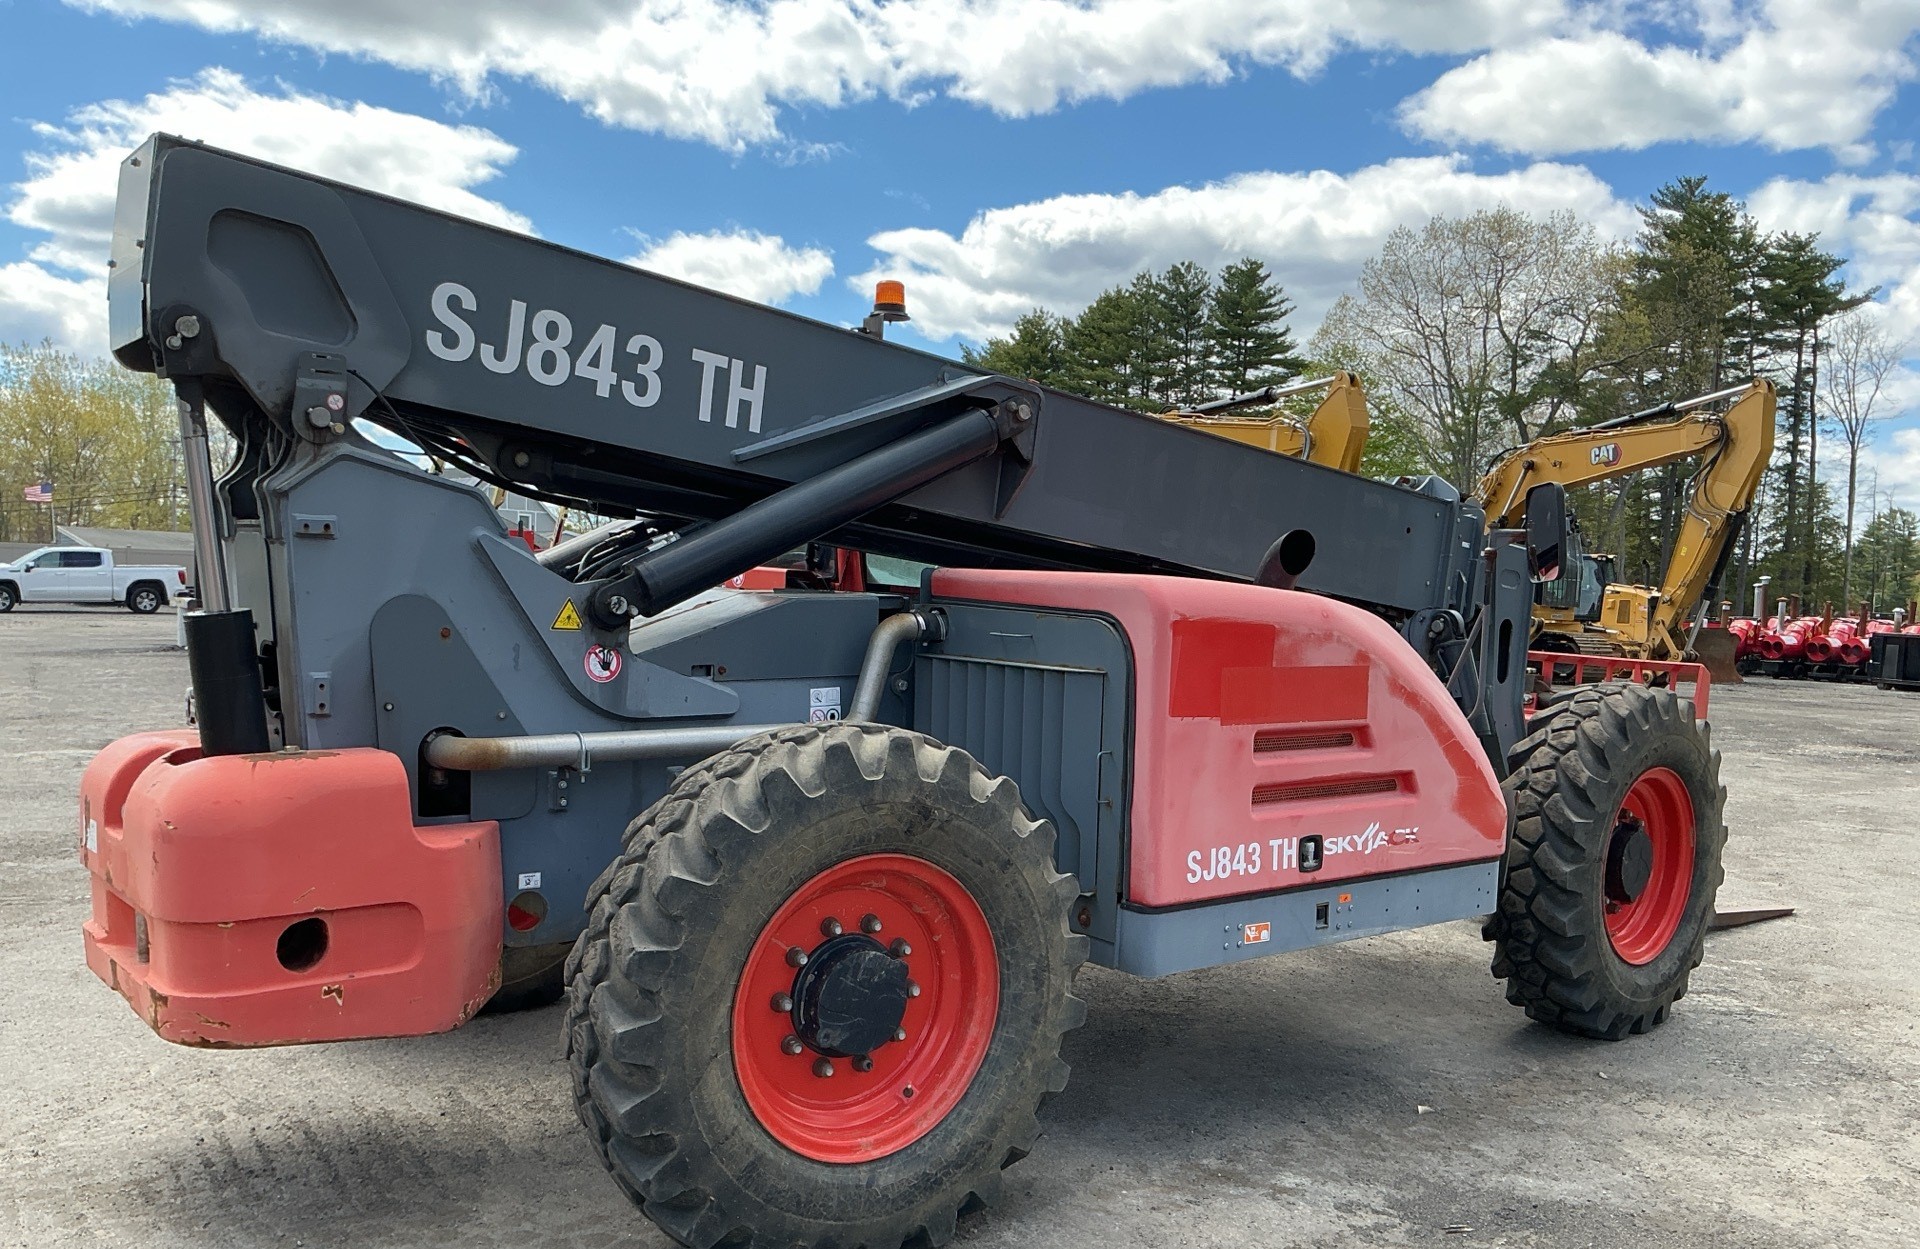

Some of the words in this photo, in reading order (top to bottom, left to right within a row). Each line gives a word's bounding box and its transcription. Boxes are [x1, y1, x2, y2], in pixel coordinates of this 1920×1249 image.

[426, 281, 664, 409] SJ843
[691, 347, 768, 434] TH
[1590, 443, 1615, 465] CAT
[1323, 821, 1420, 855] SKYJACK
[1186, 842, 1262, 884] SJ843
[1269, 836, 1297, 871] TH
